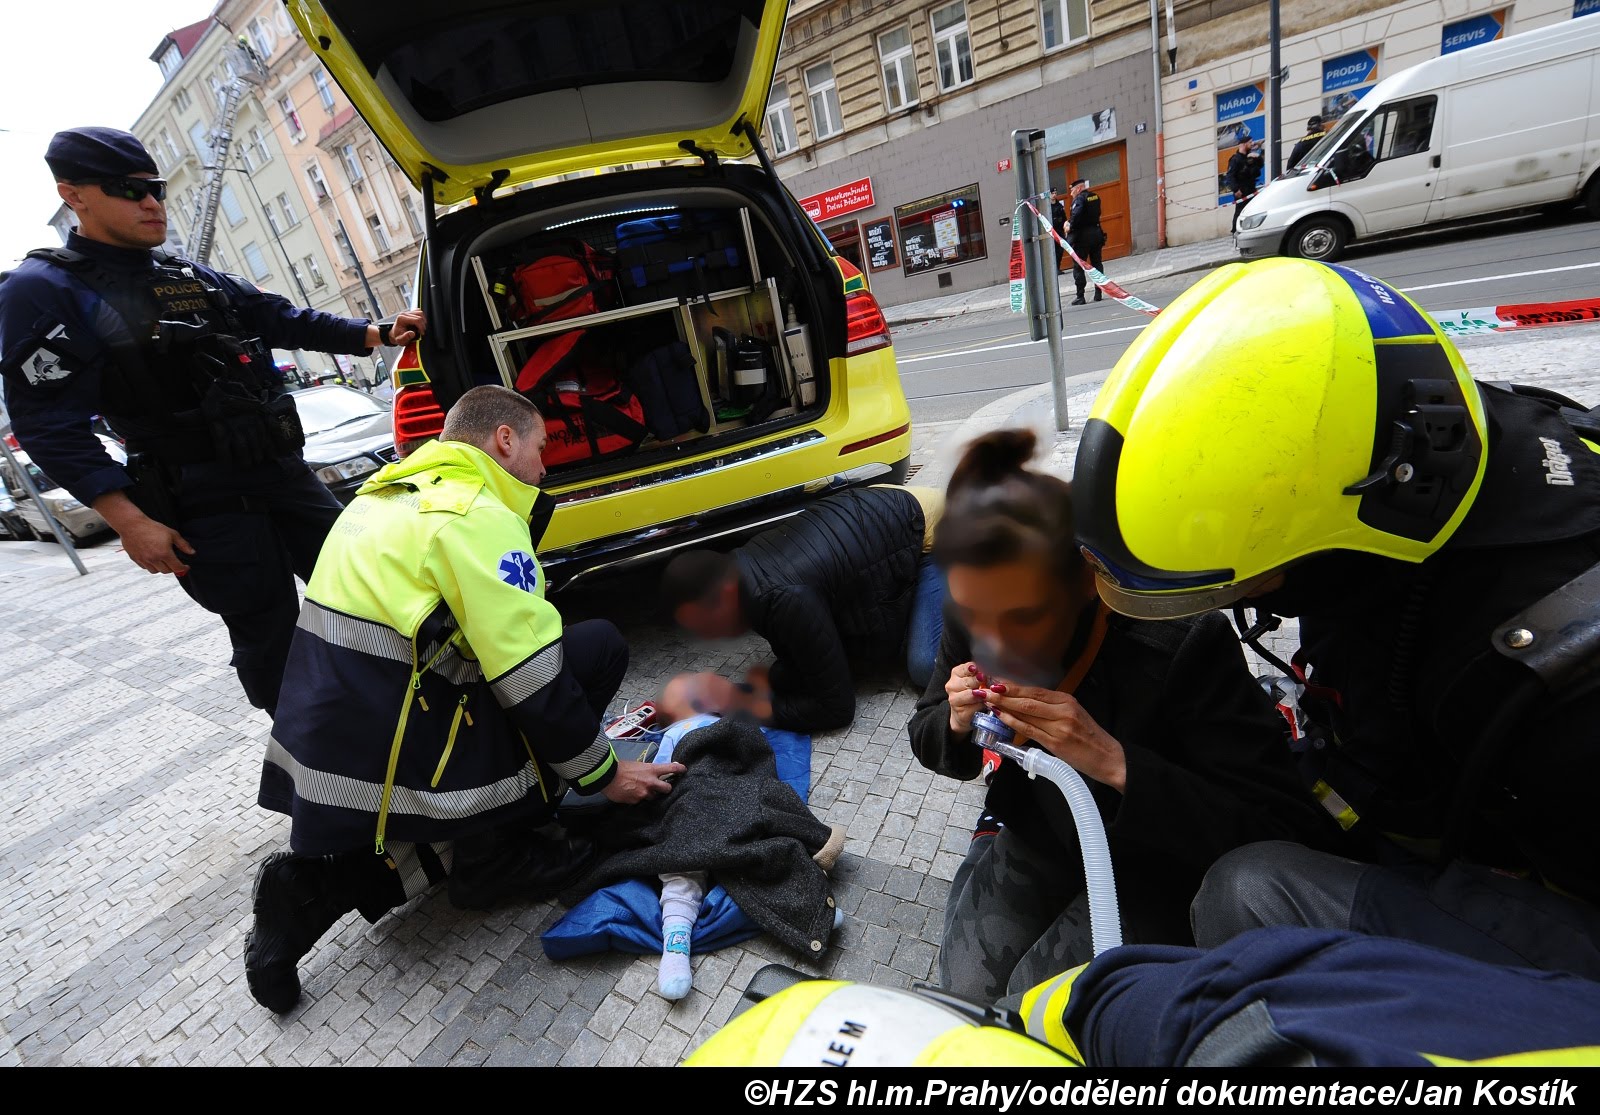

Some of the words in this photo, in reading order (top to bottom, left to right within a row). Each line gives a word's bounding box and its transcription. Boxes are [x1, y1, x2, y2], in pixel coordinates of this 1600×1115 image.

[1444, 28, 1486, 48] SERVIS
[1326, 61, 1368, 80] PRODEJ
[1219, 93, 1256, 112] NÁŘADÍ
[825, 184, 868, 204] Masokombinát
[826, 202, 843, 213] Dolní
[153, 283, 202, 297] POLICIE
[1370, 284, 1396, 305] HZS
[168, 299, 207, 312] 329210
[1538, 436, 1575, 486] Dräger
